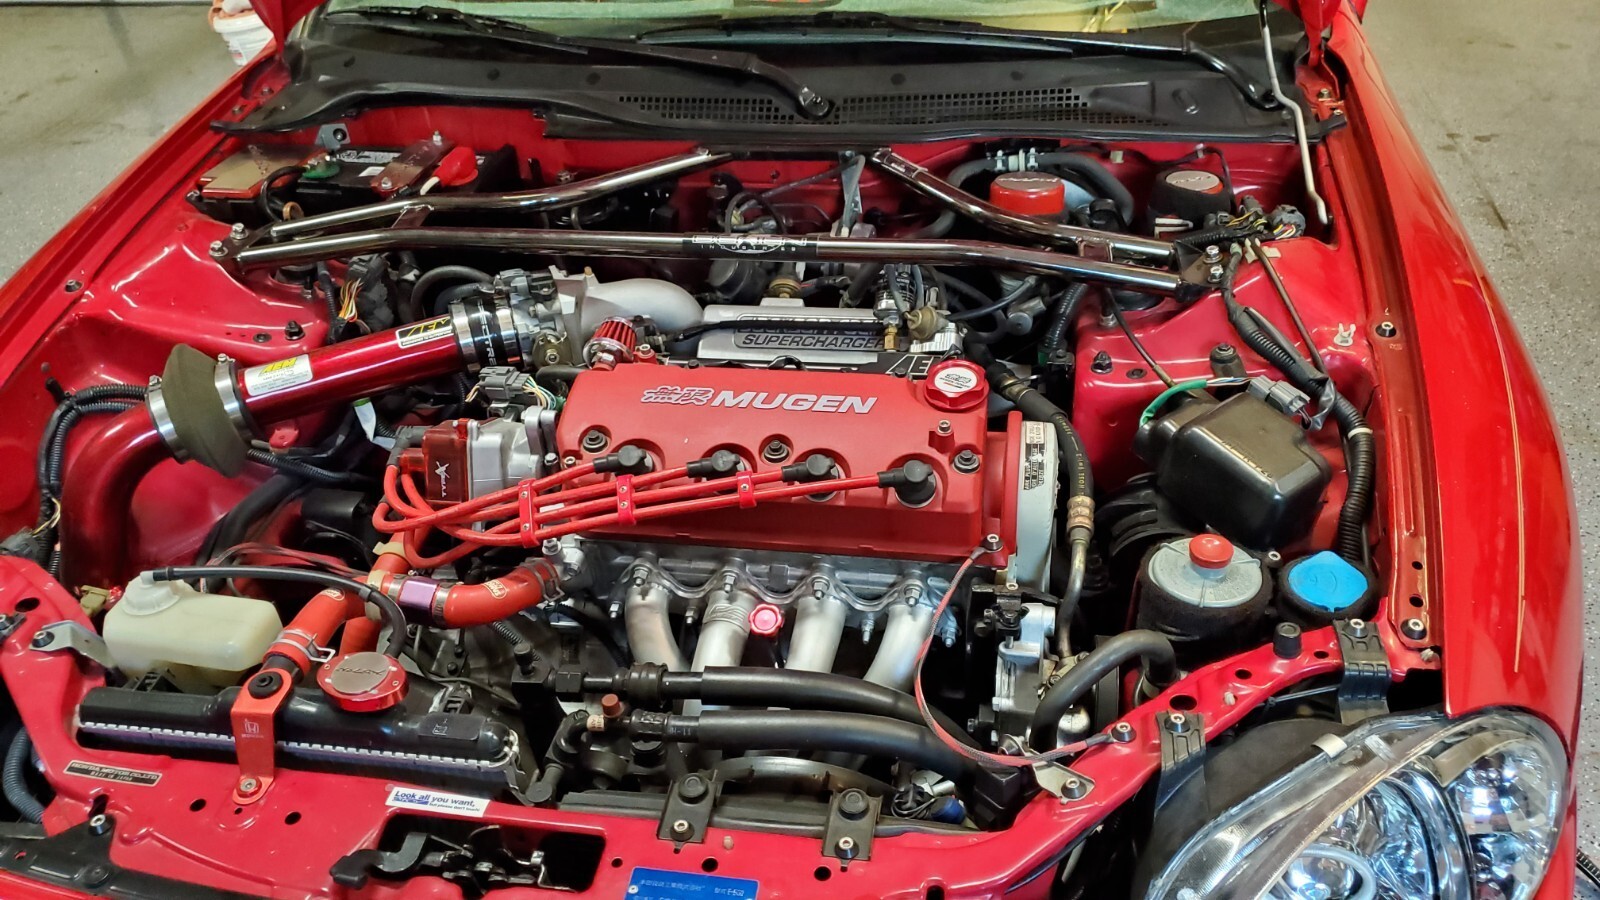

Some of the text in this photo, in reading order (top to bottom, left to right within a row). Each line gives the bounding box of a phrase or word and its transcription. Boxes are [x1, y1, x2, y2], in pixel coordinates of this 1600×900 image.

[710, 390, 878, 414] MUGEN
[395, 791, 416, 799] Look
[432, 796, 449, 804] you
[451, 798, 476, 807] want,
